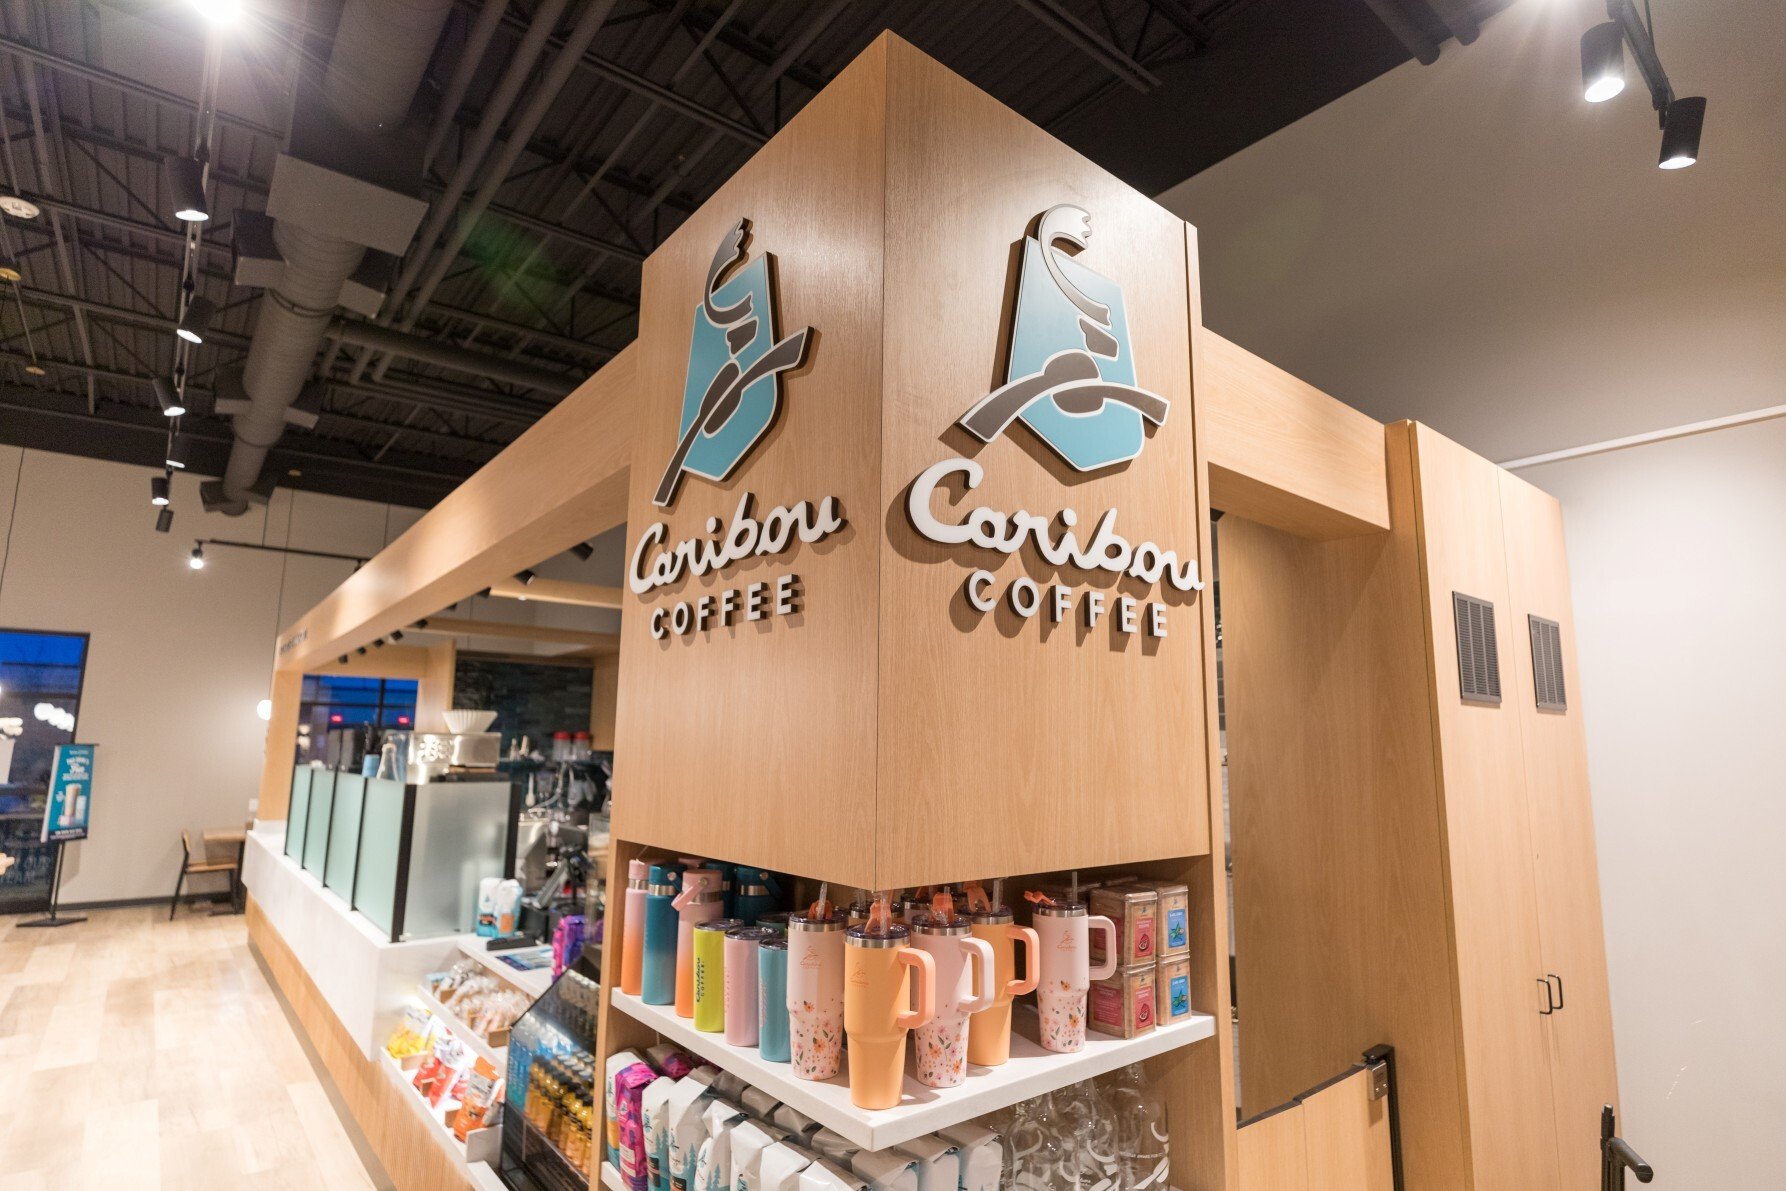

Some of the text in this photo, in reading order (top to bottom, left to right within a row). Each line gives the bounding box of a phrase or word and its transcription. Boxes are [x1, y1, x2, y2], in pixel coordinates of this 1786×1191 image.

[628, 492, 844, 595] Caribou
[908, 457, 1205, 593] Caribou
[650, 574, 801, 640] COFFEE
[966, 569, 1168, 638] COFFEE
